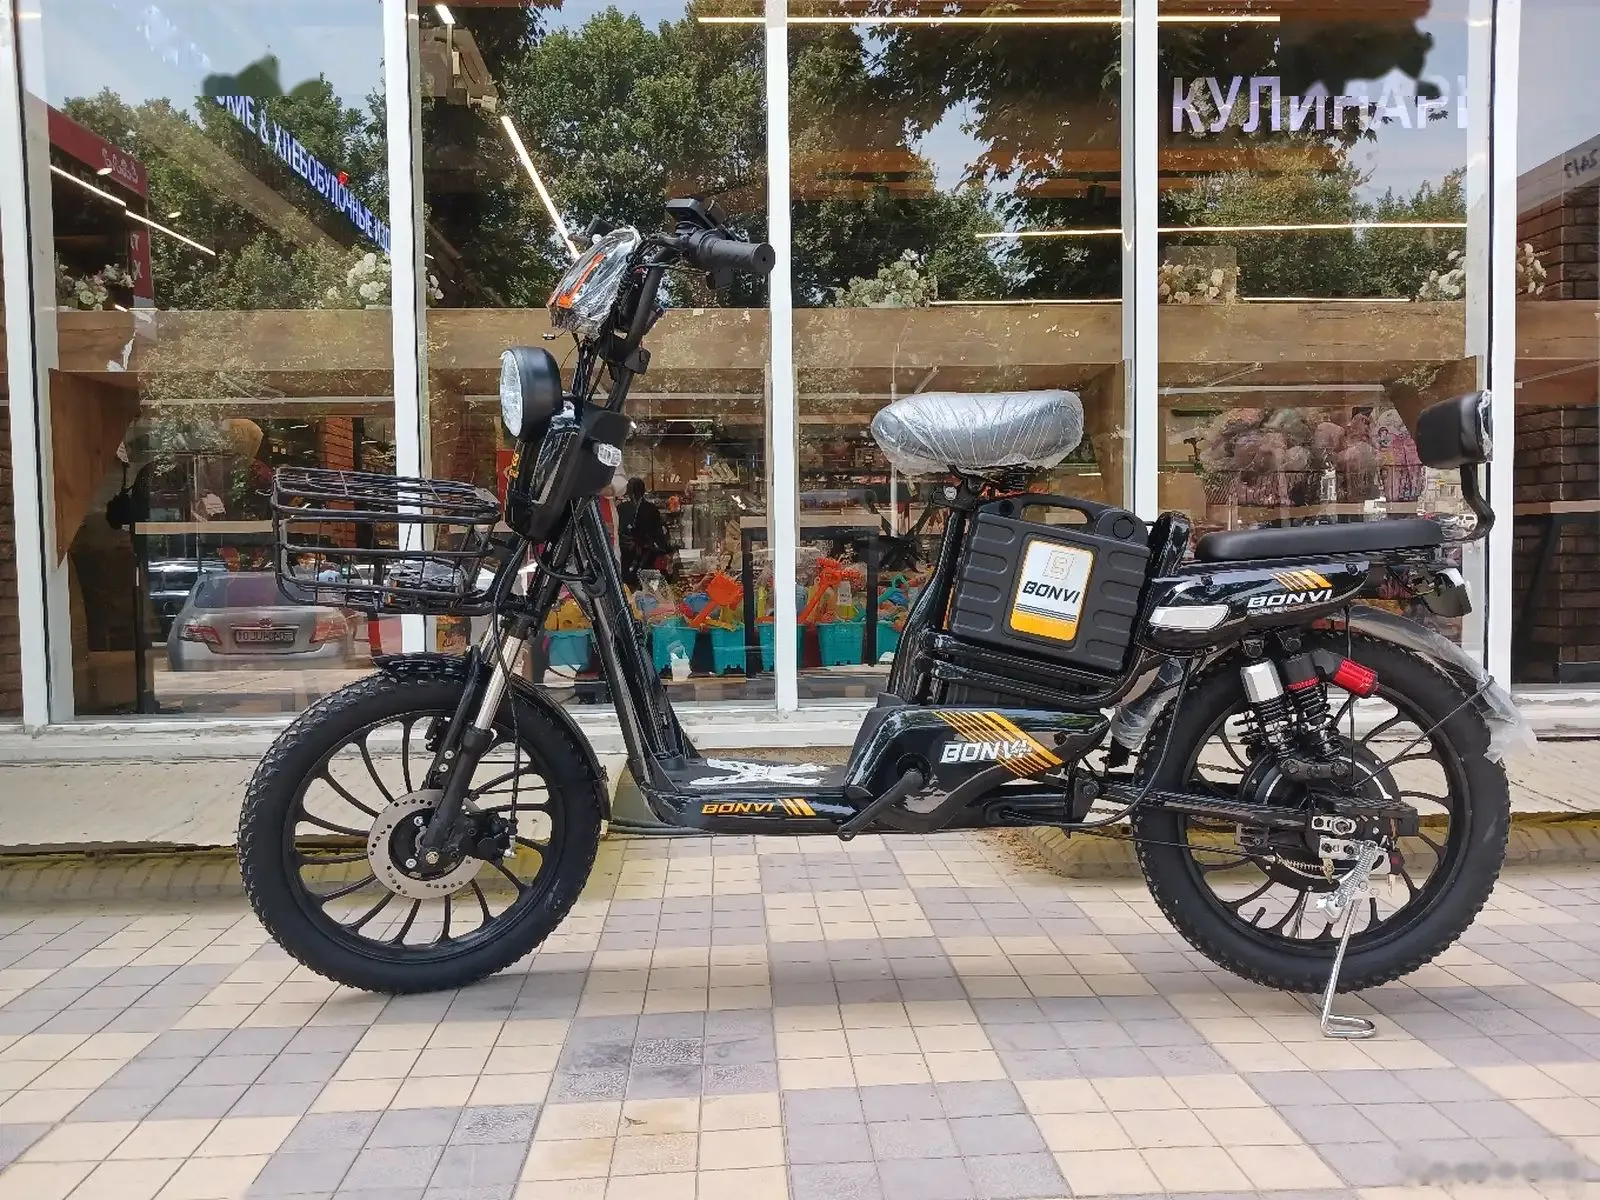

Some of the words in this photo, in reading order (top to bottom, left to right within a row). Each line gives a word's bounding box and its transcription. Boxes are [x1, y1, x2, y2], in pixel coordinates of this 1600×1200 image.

[260, 109, 270, 145] &
[1022, 580, 1081, 604] BONVI
[1247, 589, 1333, 608] BONVI
[702, 802, 774, 815] BONVI
